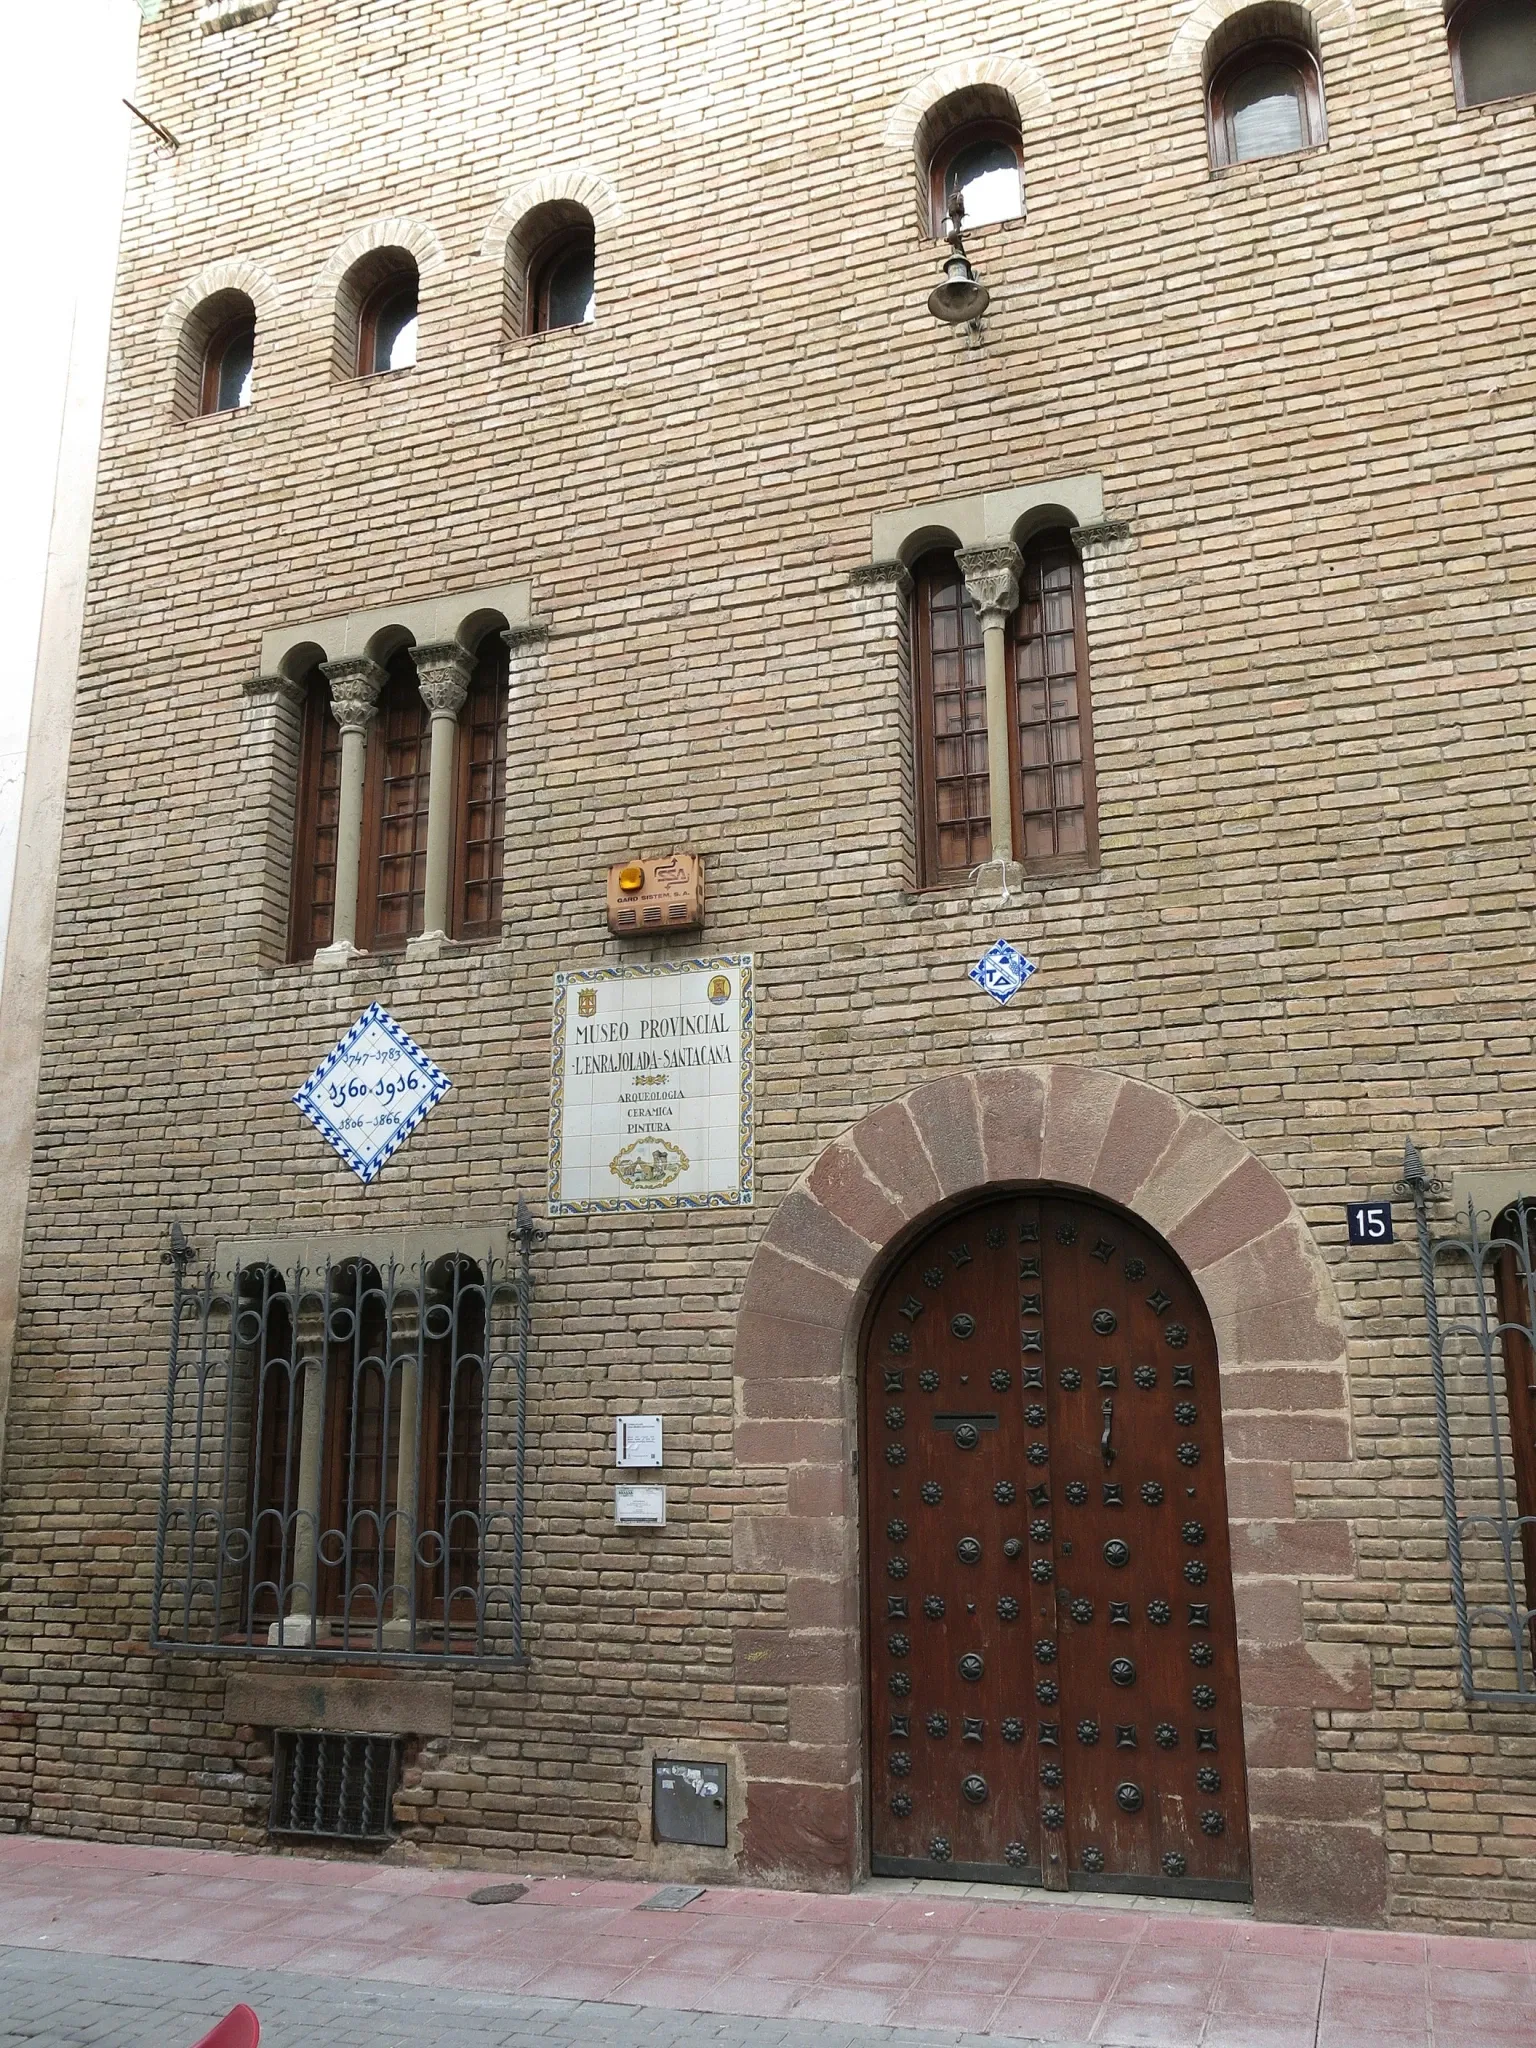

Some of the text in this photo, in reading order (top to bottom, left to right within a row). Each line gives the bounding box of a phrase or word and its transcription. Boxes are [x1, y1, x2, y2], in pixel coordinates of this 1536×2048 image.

[575, 1013, 730, 1045] MUSEO PROVINCIAL
[329, 1069, 418, 1108] 1560 1916
[617, 1090, 685, 1104] ARQUEOLOGIA
[627, 1106, 673, 1117] CERAMICA
[627, 1122, 671, 1134] PINTURA
[1356, 1209, 1385, 1237] 15
